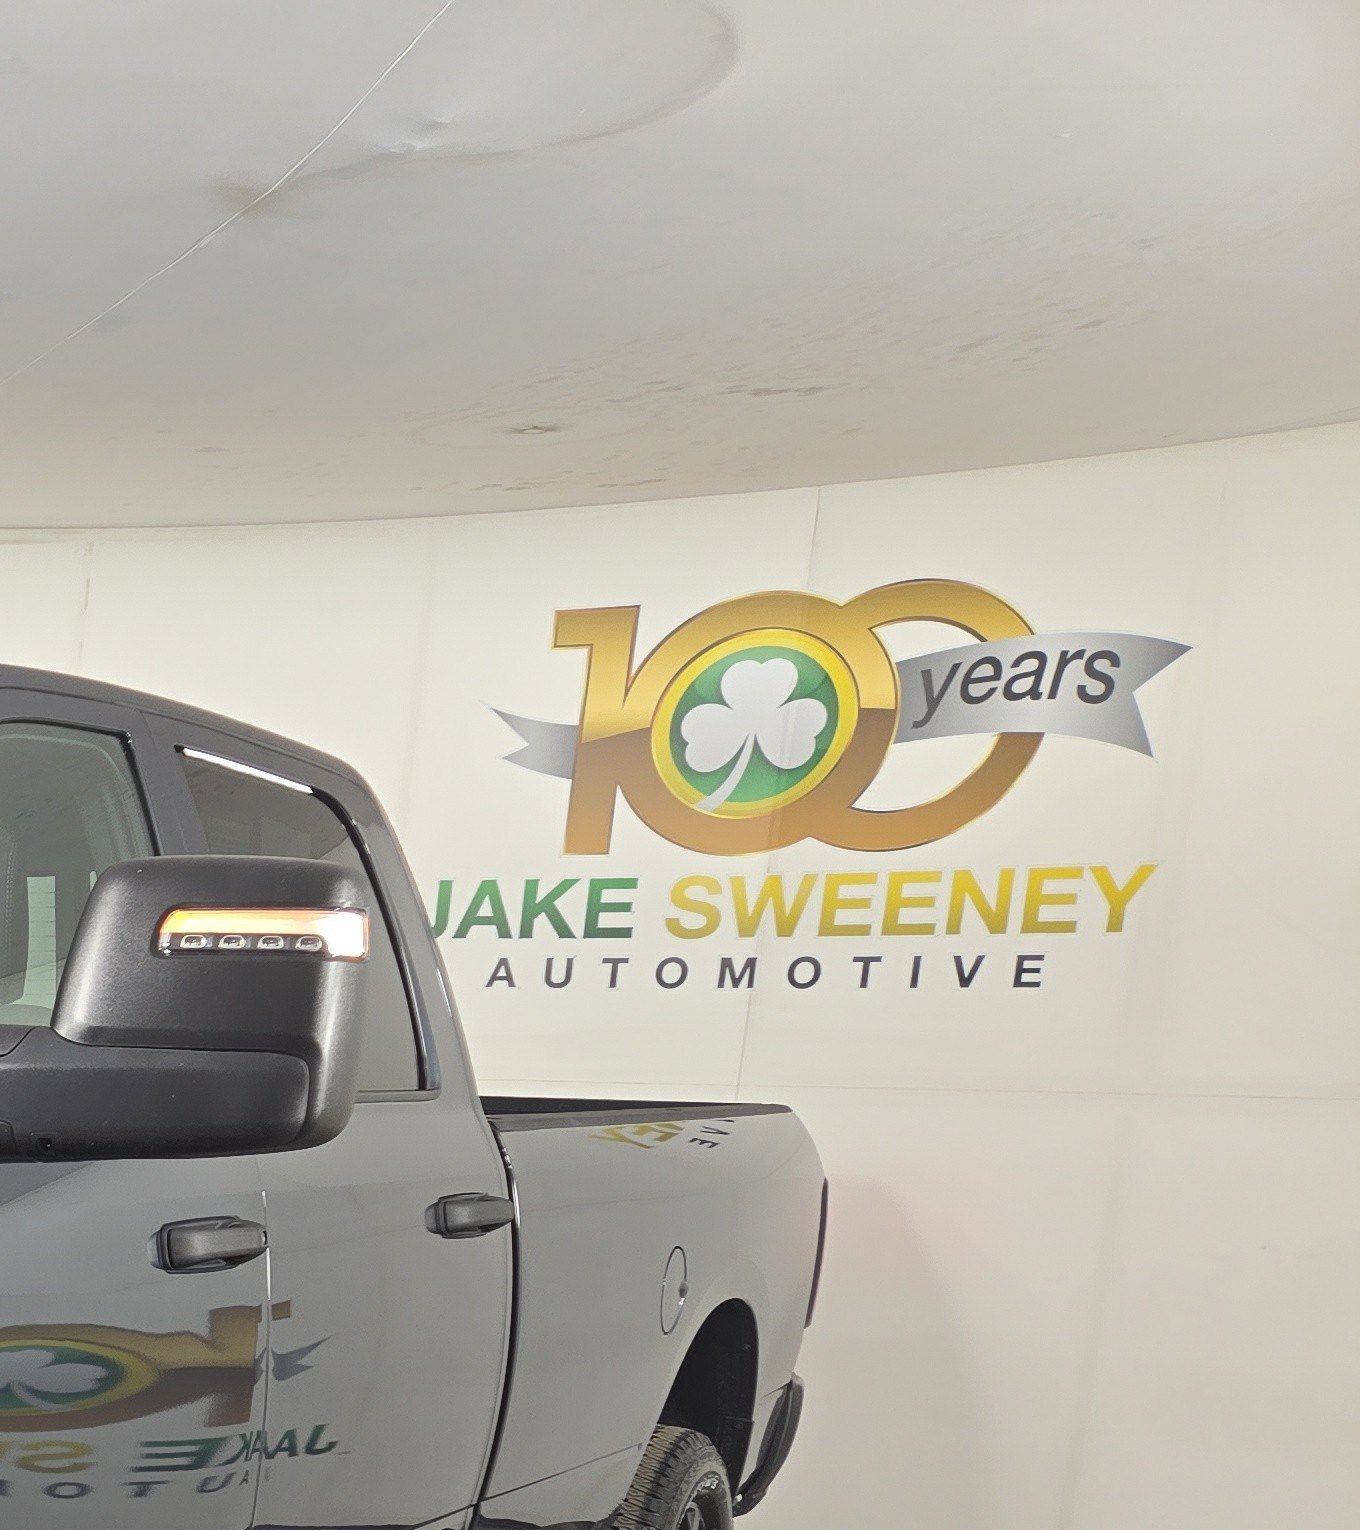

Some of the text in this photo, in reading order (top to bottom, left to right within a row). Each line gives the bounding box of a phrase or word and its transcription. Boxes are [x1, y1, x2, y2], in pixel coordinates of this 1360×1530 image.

[551, 577, 1122, 857] 100 years
[430, 862, 1159, 941] JAKE SWEENEY
[484, 953, 1047, 990] AUTOMOTIVE
